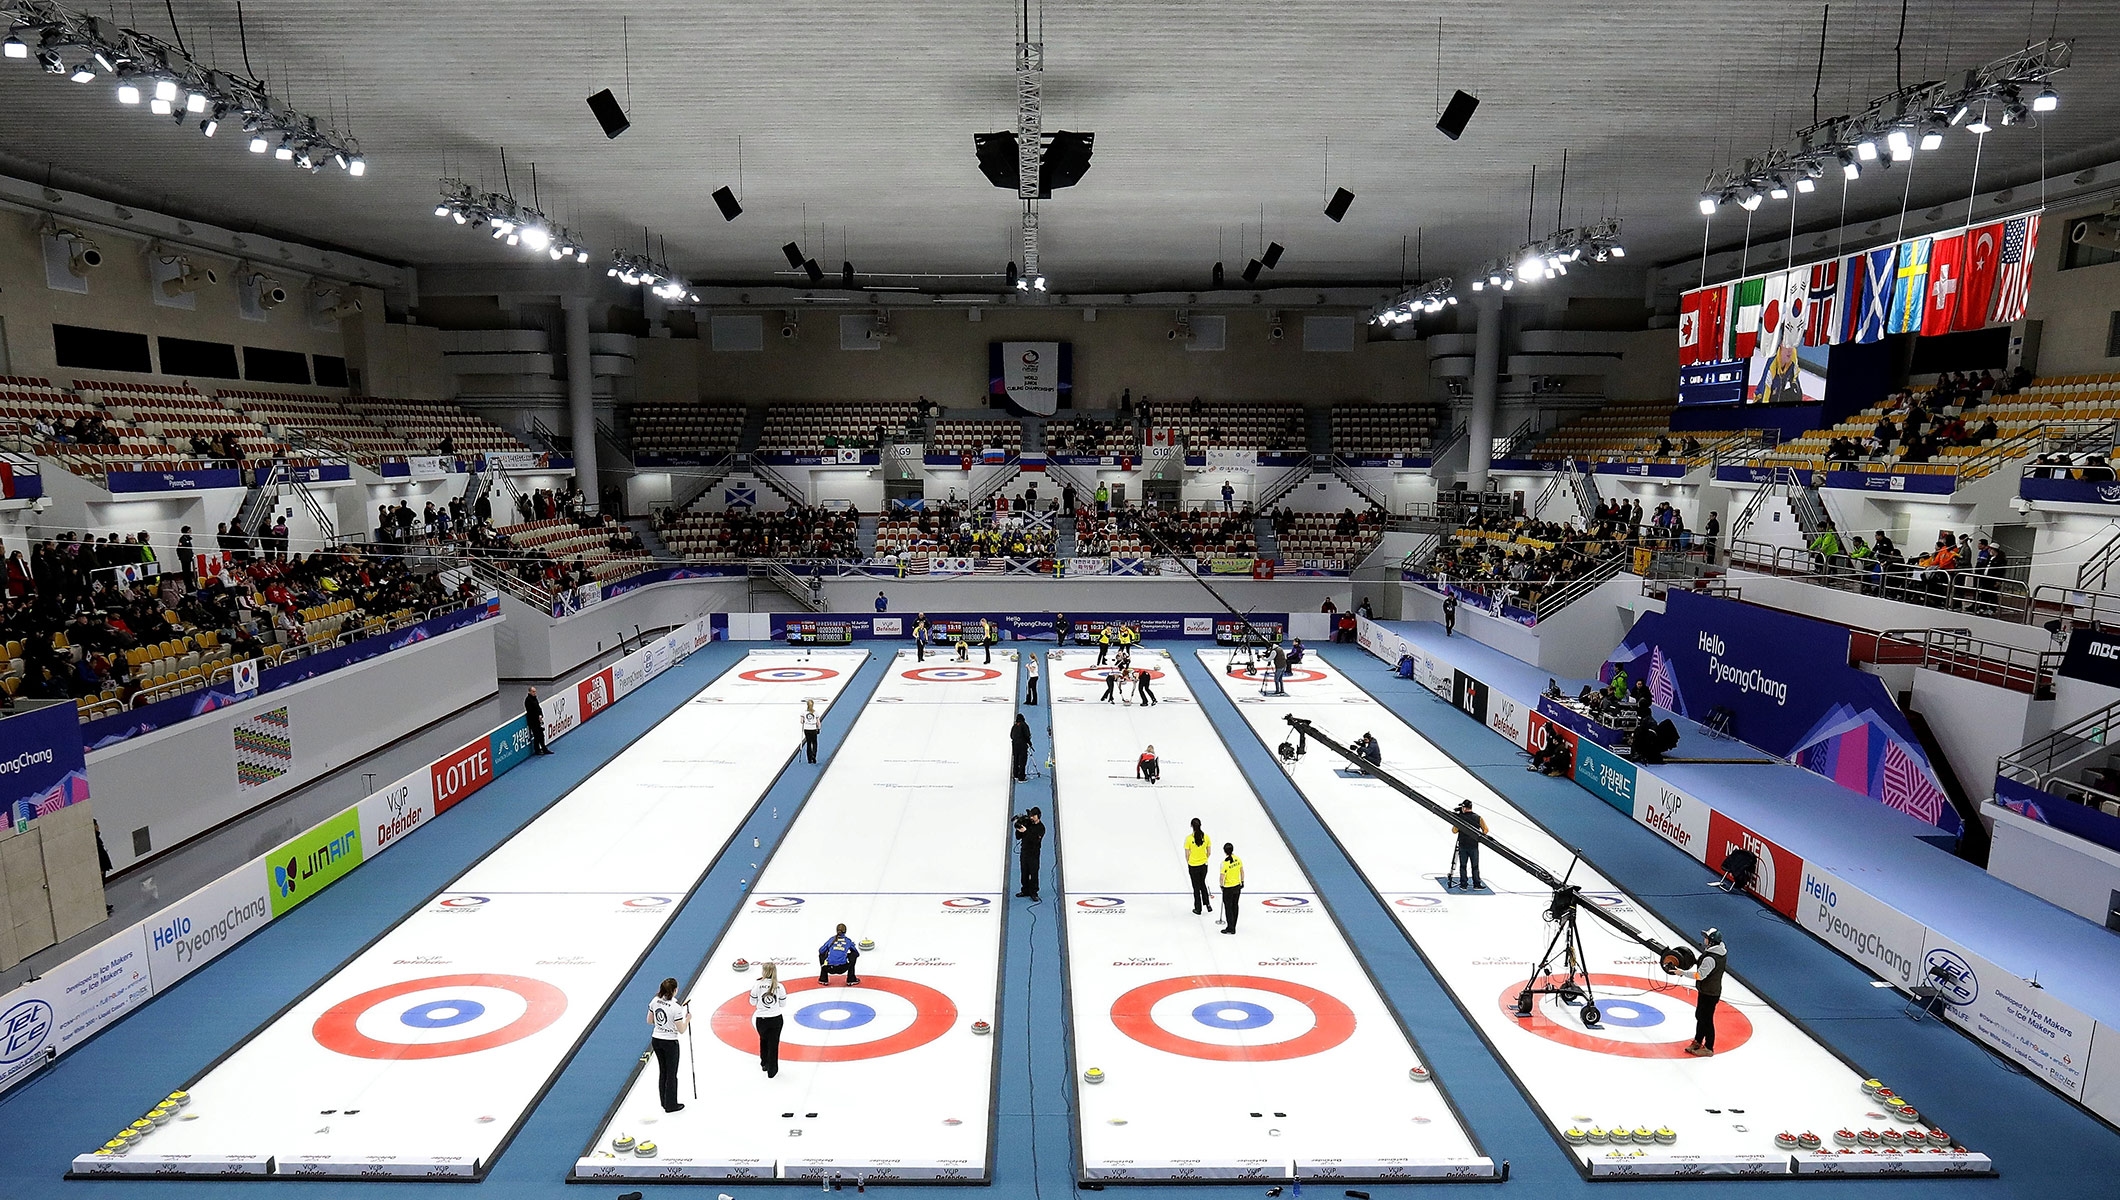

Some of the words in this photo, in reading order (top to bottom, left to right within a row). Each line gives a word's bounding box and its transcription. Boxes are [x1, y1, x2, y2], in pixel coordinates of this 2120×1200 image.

[899, 448, 911, 456] G9
[1153, 448, 1168, 456] G10
[1323, 560, 1341, 568] USA
[1698, 630, 1725, 657] Hello
[2088, 640, 2120, 660] MBC
[1709, 655, 1788, 706] PyeongChang
[547, 714, 573, 739] Defender
[1493, 713, 1519, 740] Defender
[0, 749, 53, 774] ongChang
[436, 748, 489, 801] LOTTE
[1600, 763, 1632, 799] 강원랜드
[377, 807, 422, 847] Defender
[1645, 804, 1691, 846] Defender
[1742, 831, 1762, 856] THE
[1805, 873, 1837, 908] Hello
[153, 917, 191, 952] Hello
[175, 896, 266, 962] PyeongChang
[1818, 904, 1912, 982] PyeongChang
[110, 951, 133, 969] Makers
[88, 980, 100, 991] Ice
[100, 967, 123, 985] Makers
[1995, 989, 2027, 1010] Developed
[2031, 1008, 2043, 1020] Ice
[2043, 1017, 2073, 1038] Makers
[2007, 1006, 2015, 1015] for
[2015, 1011, 2027, 1022] Ice
[2027, 1019, 2056, 1039] Makers
[788, 1129, 803, 1137] B
[1269, 1128, 1281, 1137] C
